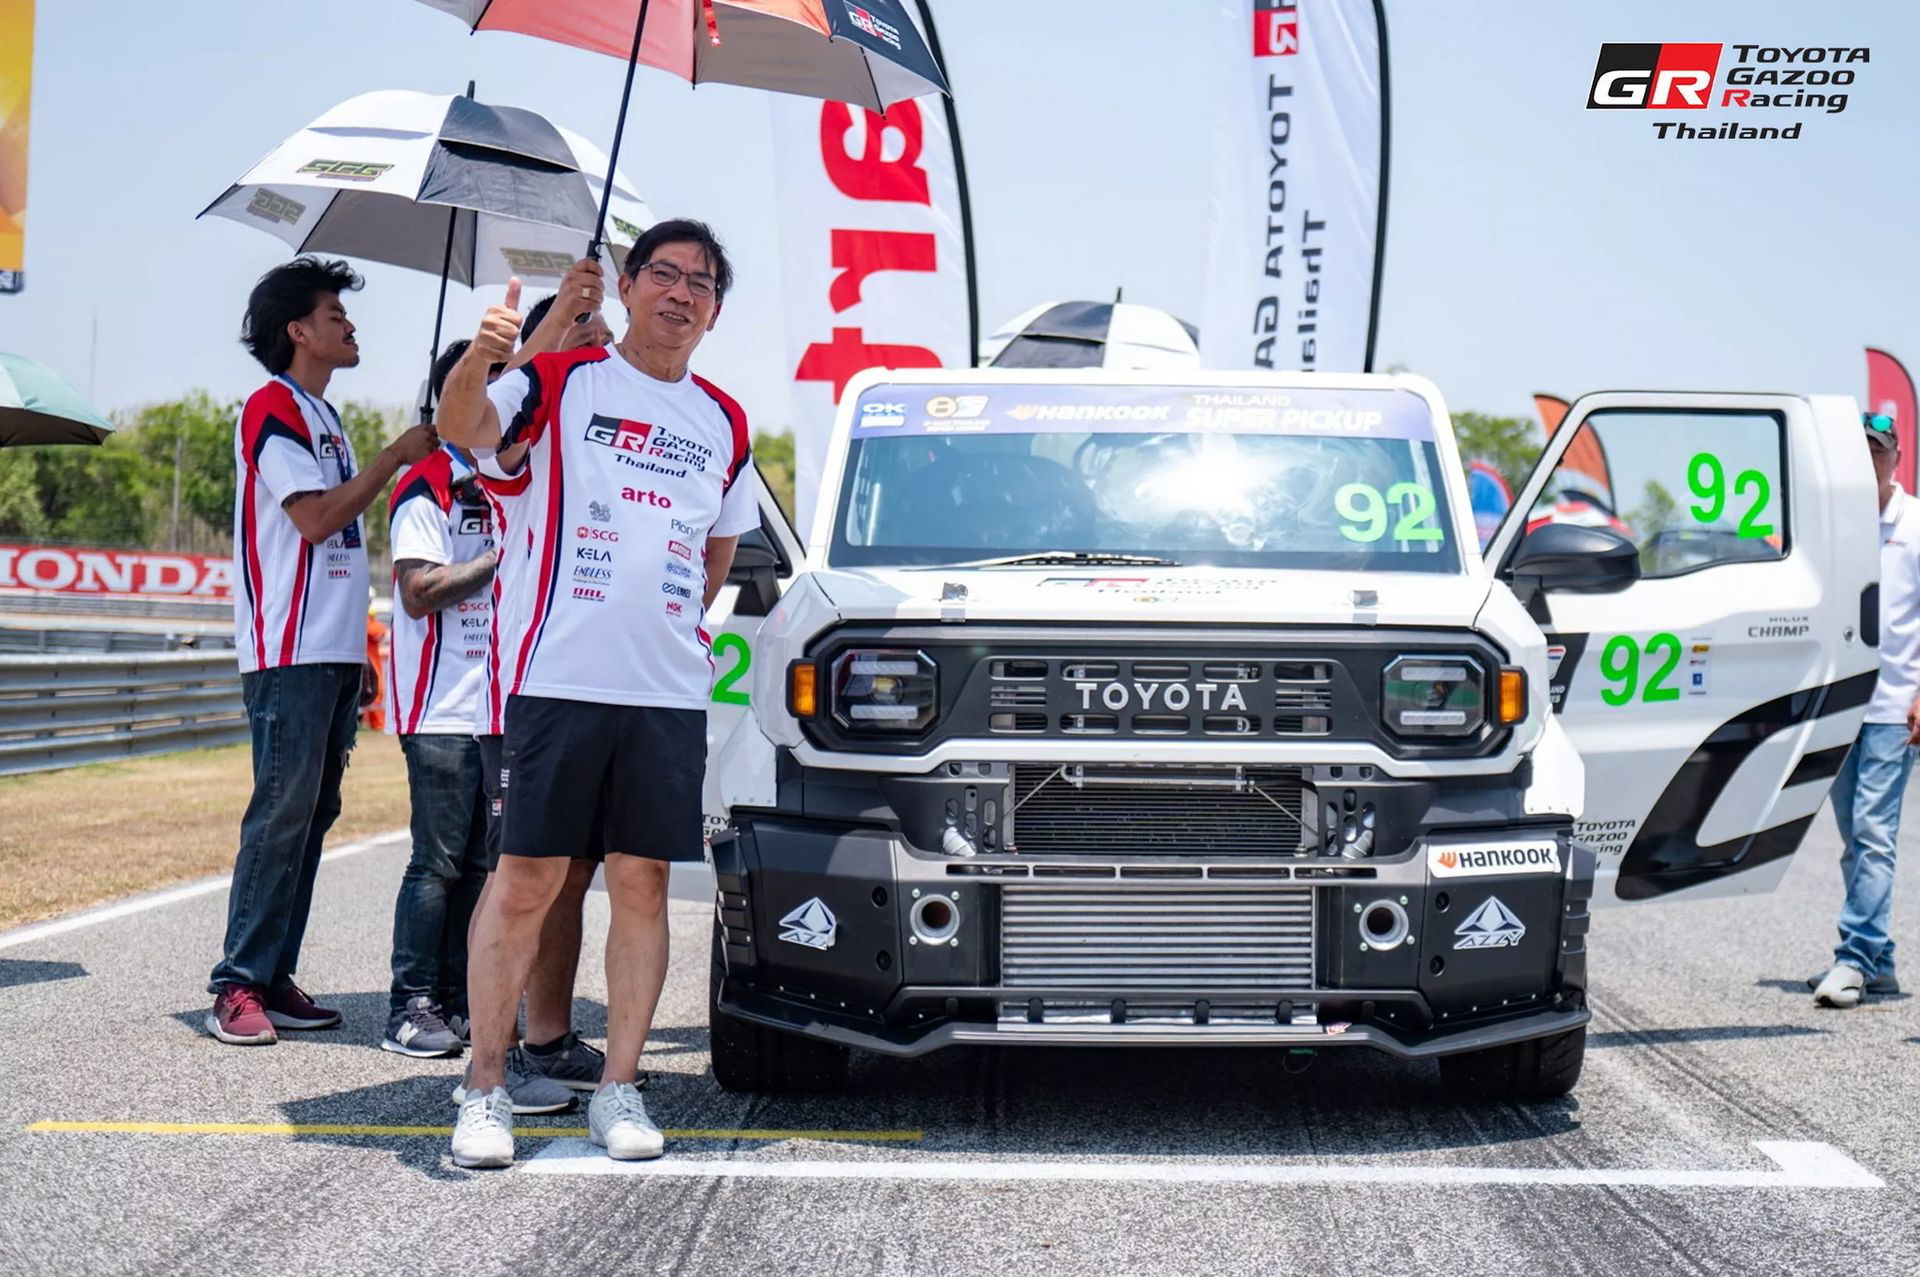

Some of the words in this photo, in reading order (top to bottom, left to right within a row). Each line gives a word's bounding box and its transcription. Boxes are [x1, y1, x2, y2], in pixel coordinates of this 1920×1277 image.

[848, 10, 877, 37] GR
[1193, 394, 1292, 407] THAILAND
[1184, 407, 1278, 430] SUPER
[1281, 409, 1383, 433] PICKUP
[586, 424, 646, 453] GR
[614, 453, 687, 479] Thailand
[647, 446, 706, 473] Racing
[621, 487, 672, 509] arto
[1686, 452, 1774, 539] 92
[1334, 481, 1445, 543] 92
[592, 528, 619, 542] SCG
[576, 547, 612, 563] KELA
[573, 565, 614, 580] ENDLESS
[666, 601, 683, 613] NGK
[1747, 625, 1810, 638] CHAMP
[1600, 632, 1682, 707] 92
[1075, 682, 1248, 711] TOYOTA
[1577, 819, 1636, 833] TOYOTA
